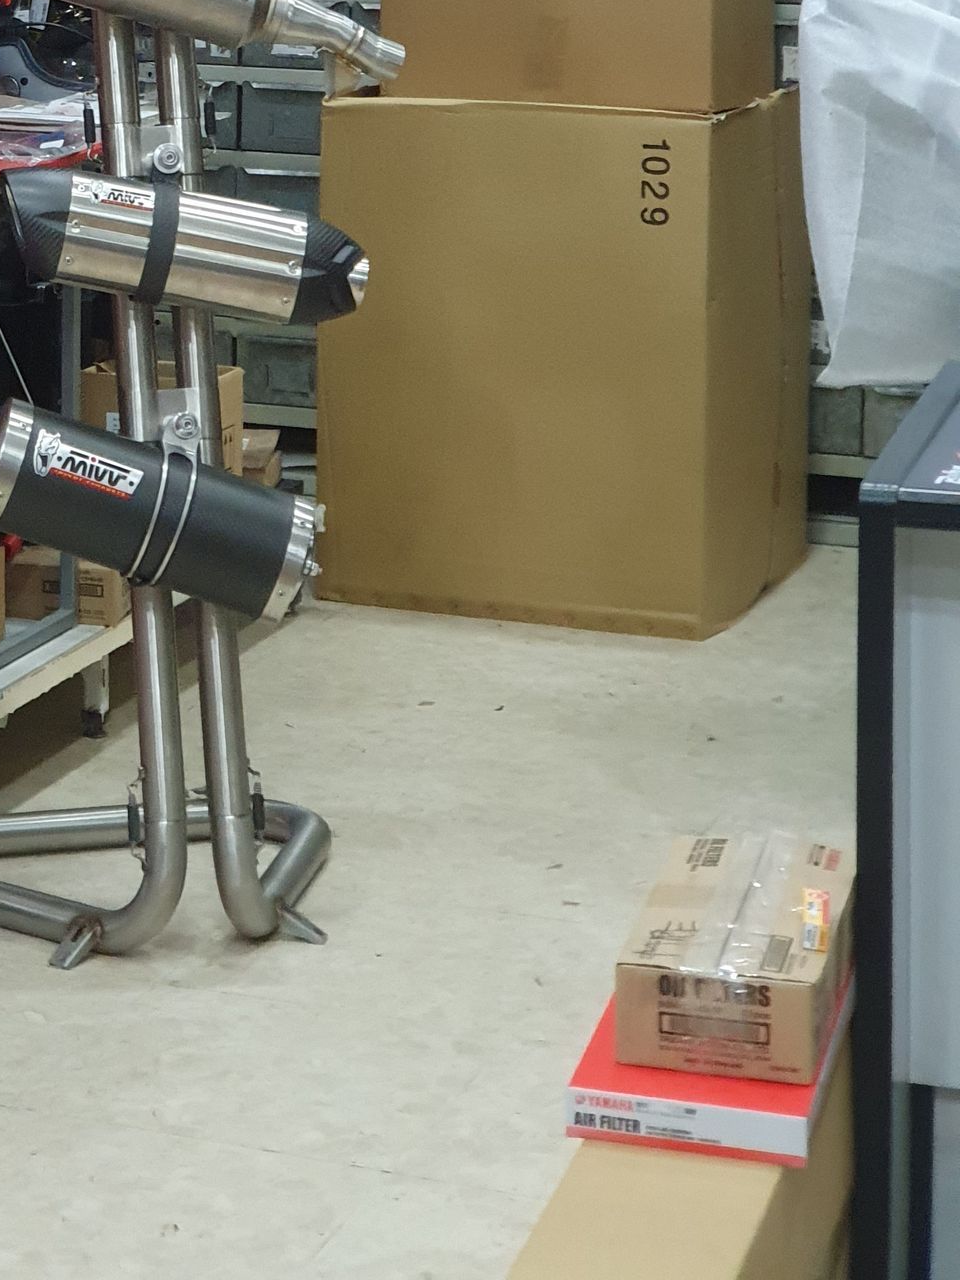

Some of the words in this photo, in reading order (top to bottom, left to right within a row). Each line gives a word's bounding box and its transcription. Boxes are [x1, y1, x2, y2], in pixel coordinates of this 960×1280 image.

[640, 140, 671, 226] 1029
[575, 1112, 597, 1128] AIR
[599, 1115, 641, 1134] FILTER
